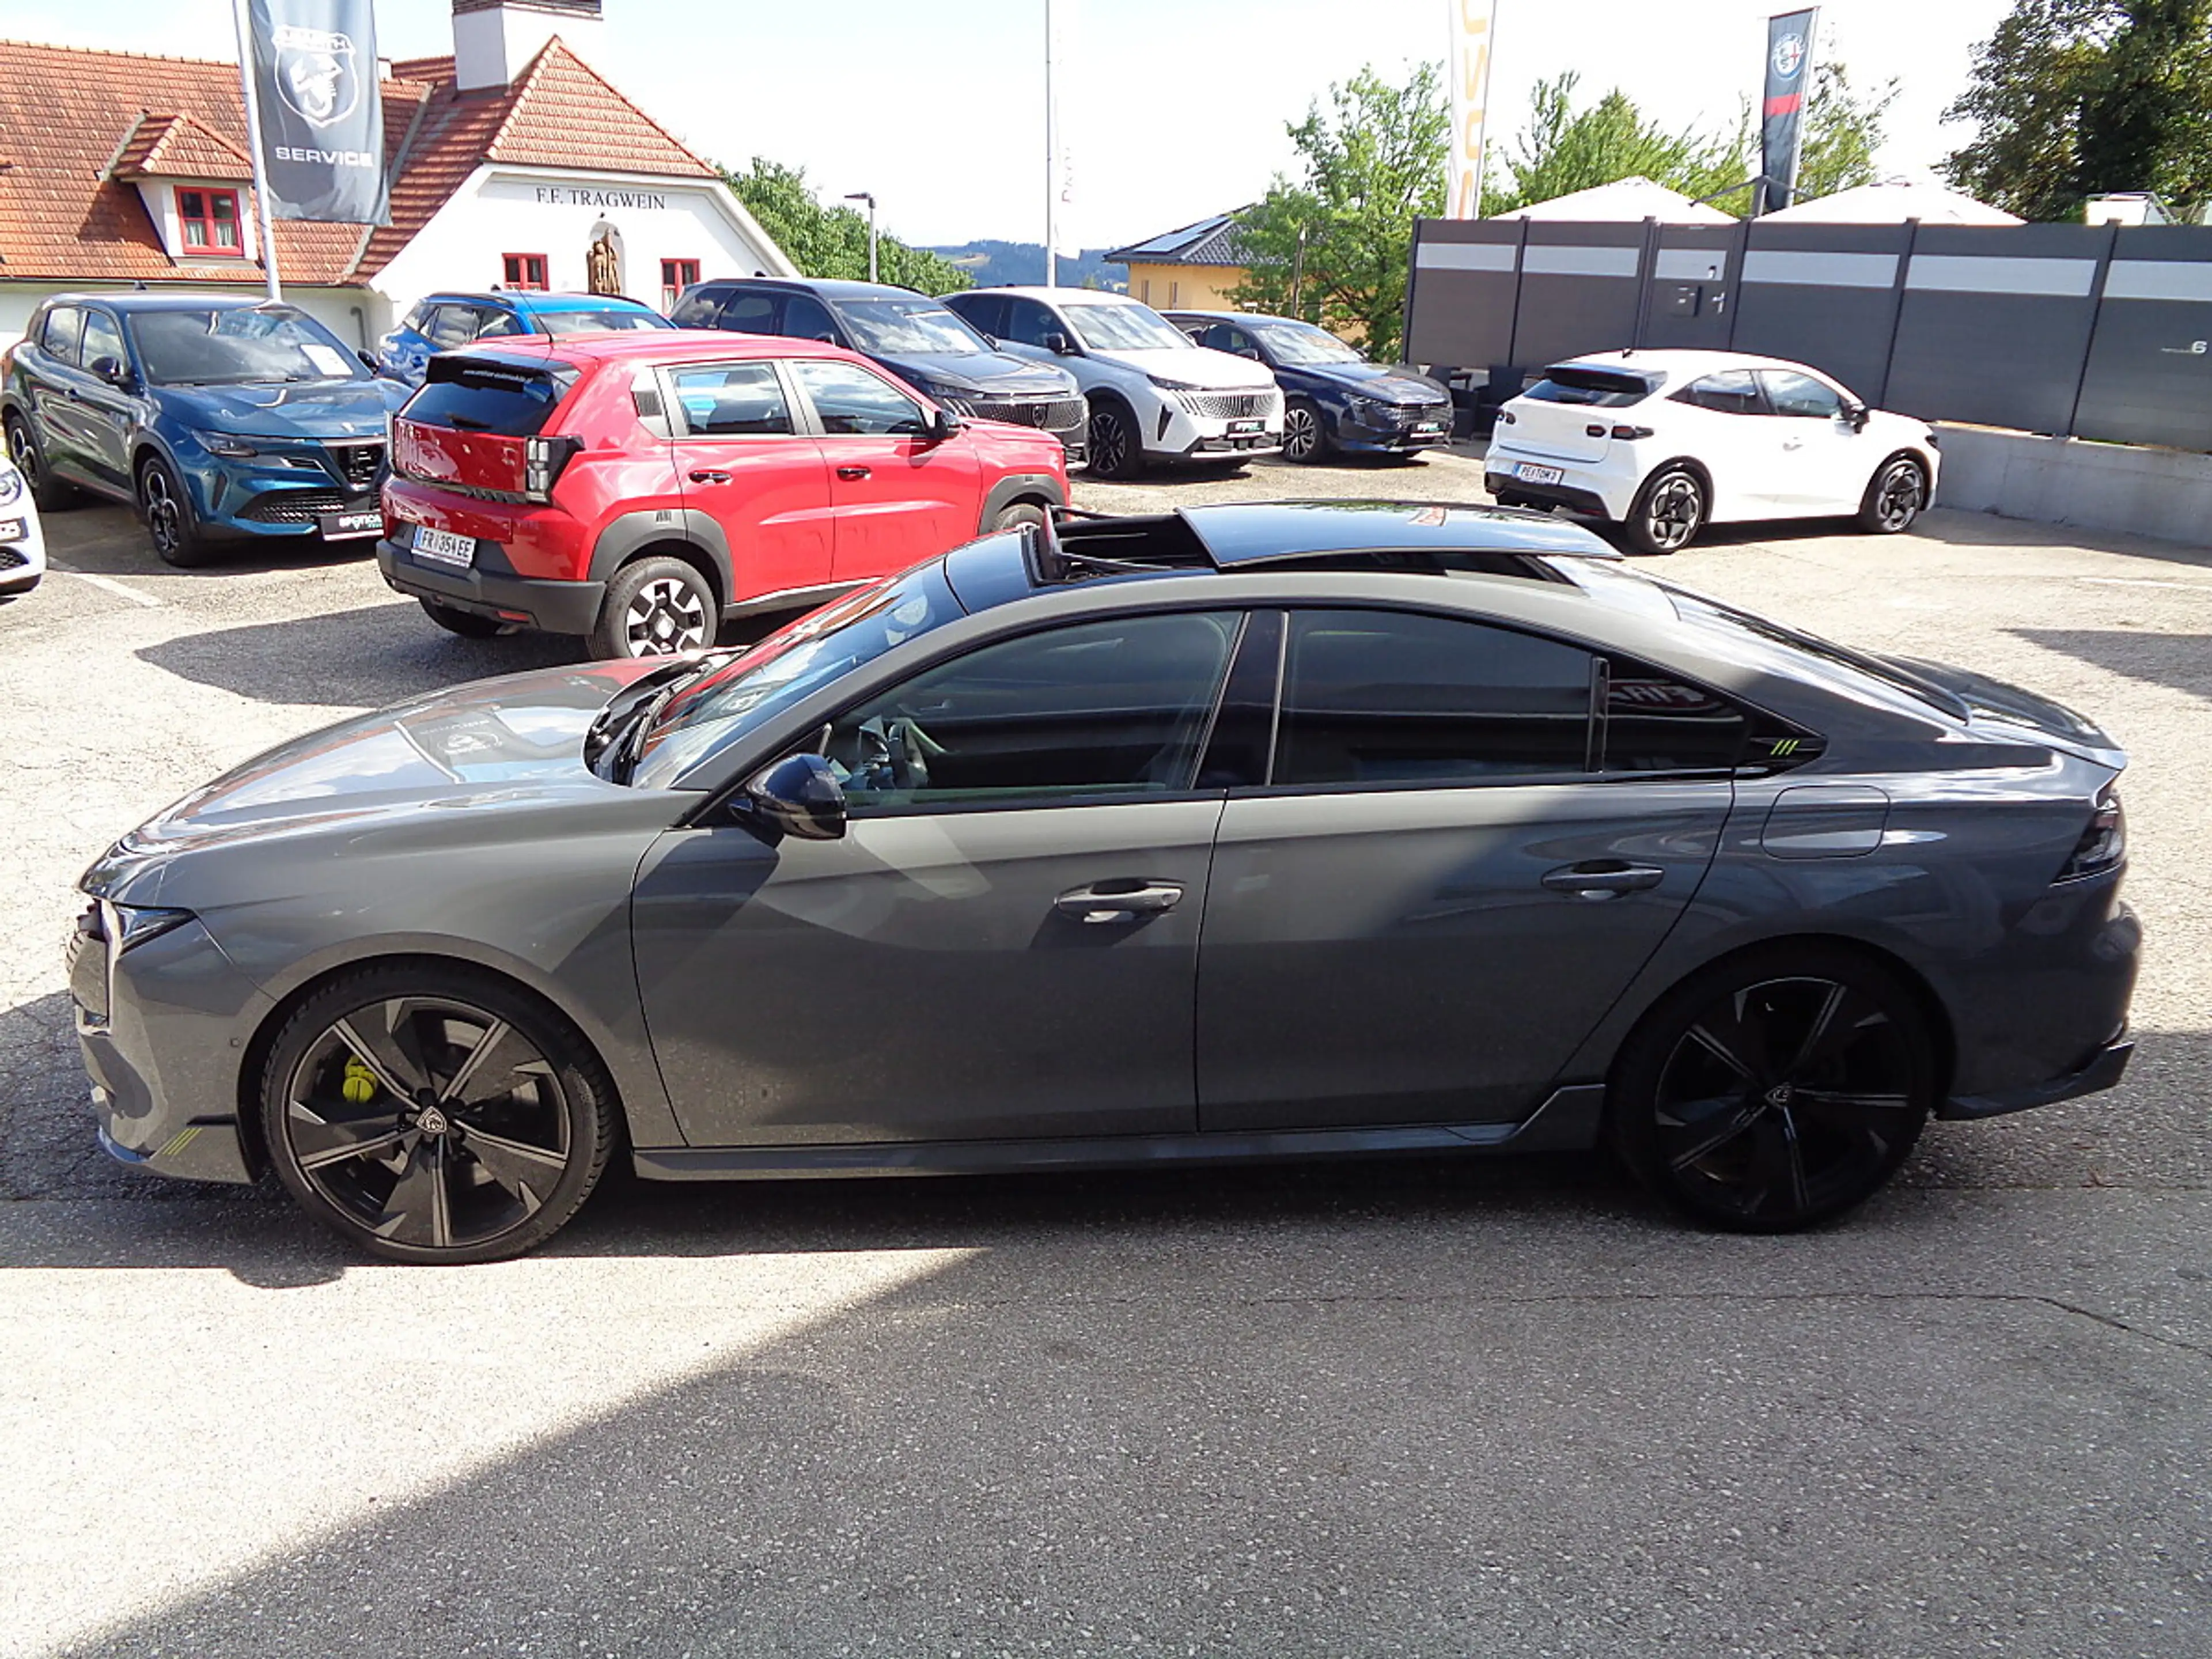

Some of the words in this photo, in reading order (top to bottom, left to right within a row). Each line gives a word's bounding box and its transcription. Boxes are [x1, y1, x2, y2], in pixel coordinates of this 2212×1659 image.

[275, 146, 373, 167] SERVICE
[568, 189, 665, 210] TRAGWEIN
[2191, 340, 2207, 353] 6
